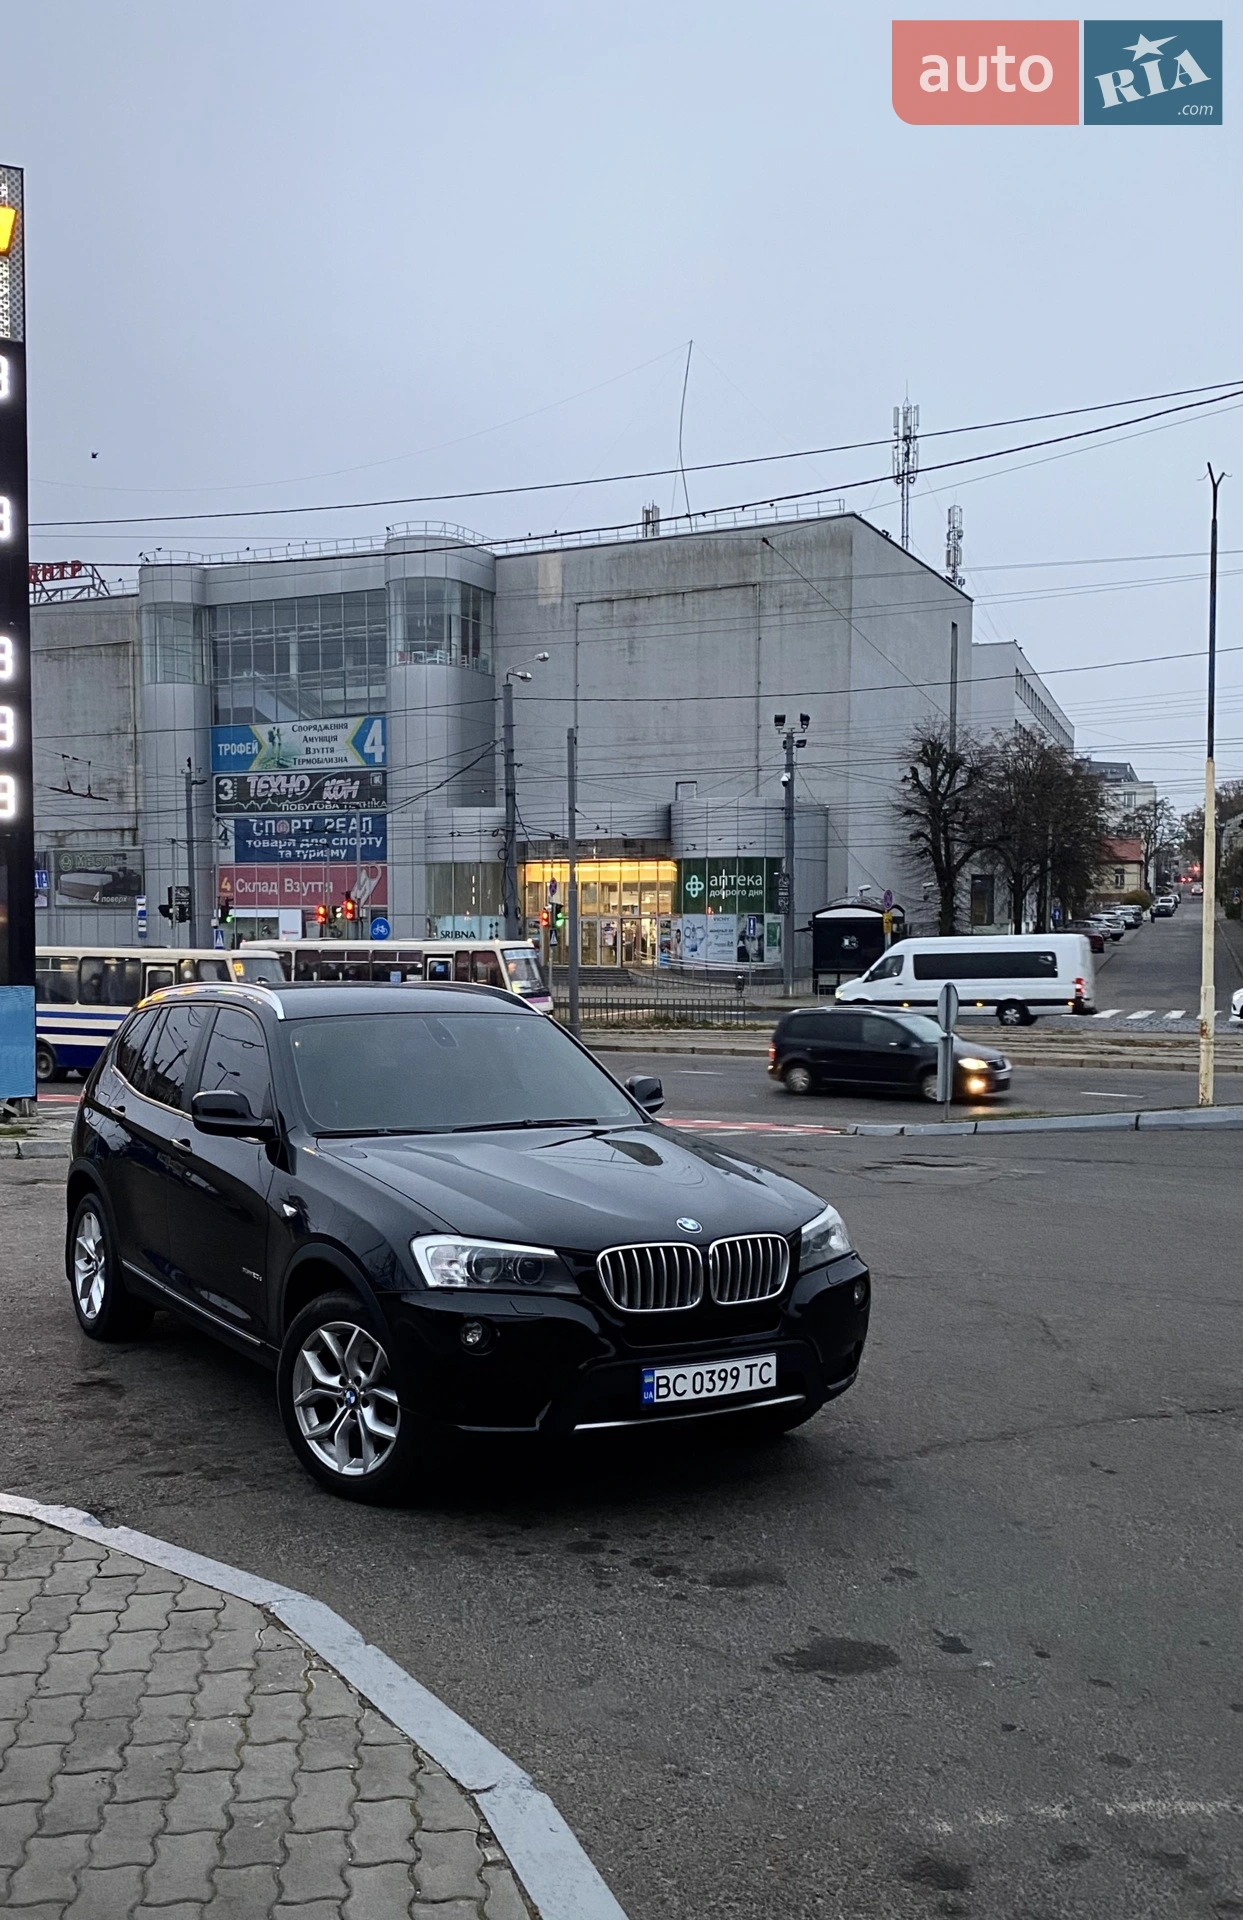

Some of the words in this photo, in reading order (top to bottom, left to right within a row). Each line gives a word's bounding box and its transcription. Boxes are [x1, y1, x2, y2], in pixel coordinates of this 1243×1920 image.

[363, 719, 385, 763] 4
[218, 740, 259, 756] ТРОФЕЙ
[218, 778, 234, 801] 3
[247, 774, 311, 798] ТЕХНО
[281, 802, 340, 812] ПОБУТОВА
[246, 838, 296, 849] товари
[331, 836, 383, 848] спорту
[278, 850, 292, 859] та
[295, 848, 347, 860] туризму
[220, 876, 232, 892] 4
[236, 878, 278, 896] Склад
[284, 878, 334, 896] Взуття
[709, 874, 763, 887] аптека
[93, 891, 101, 903] 4
[709, 889, 747, 898] доброго
[748, 889, 763, 898] дня
[440, 930, 476, 939] SRIBNA
[656, 1373, 688, 1400] BC
[692, 1366, 740, 1395] 0399
[744, 1361, 772, 1387] TC
[643, 1391, 654, 1400] UA
